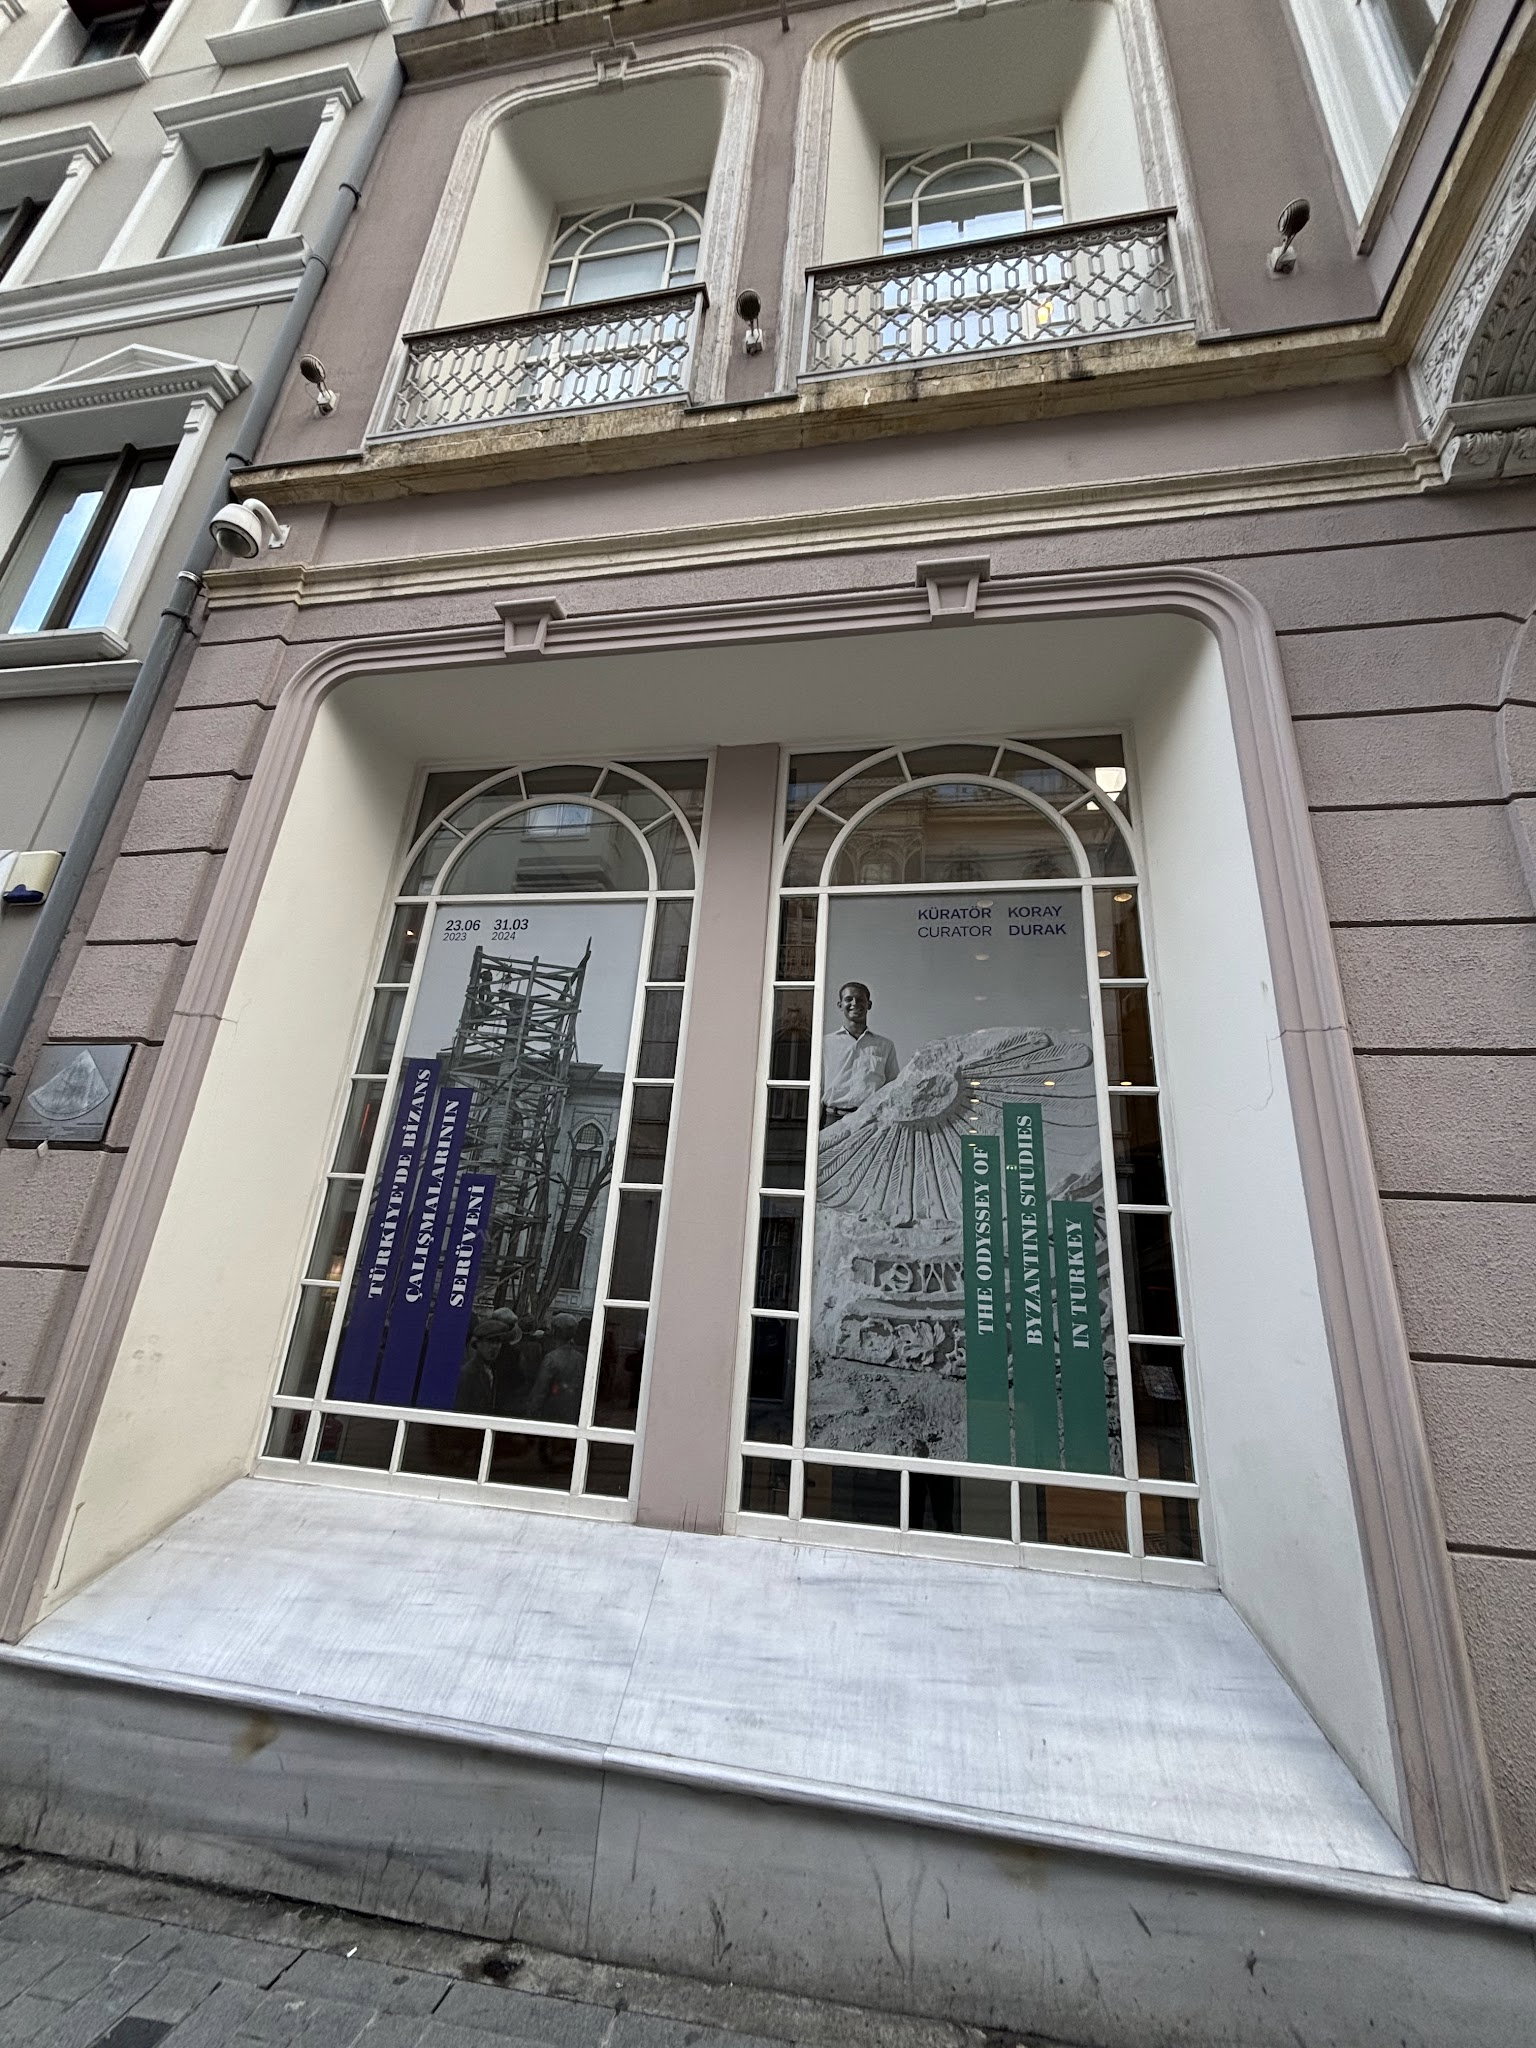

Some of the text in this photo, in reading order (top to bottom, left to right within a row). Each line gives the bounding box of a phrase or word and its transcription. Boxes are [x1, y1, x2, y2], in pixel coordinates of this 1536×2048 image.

[442, 931, 516, 941] 2023 2024
[445, 918, 529, 931] 23.06 31.03
[917, 923, 1067, 938] CURATOR DURAK
[918, 905, 1063, 920] KÜRATÖR KORAY
[368, 1069, 431, 1299] TÜRKİYE'DE BİZANS
[405, 1100, 460, 1303] ÇALIŞMALARININ
[449, 1185, 486, 1308] SERÜVENİ
[973, 1146, 994, 1336] THE ODYSSEY OF
[1016, 1115, 1043, 1345] BYZANTINE STUDIES
[1065, 1218, 1090, 1349] IN TURKEY
